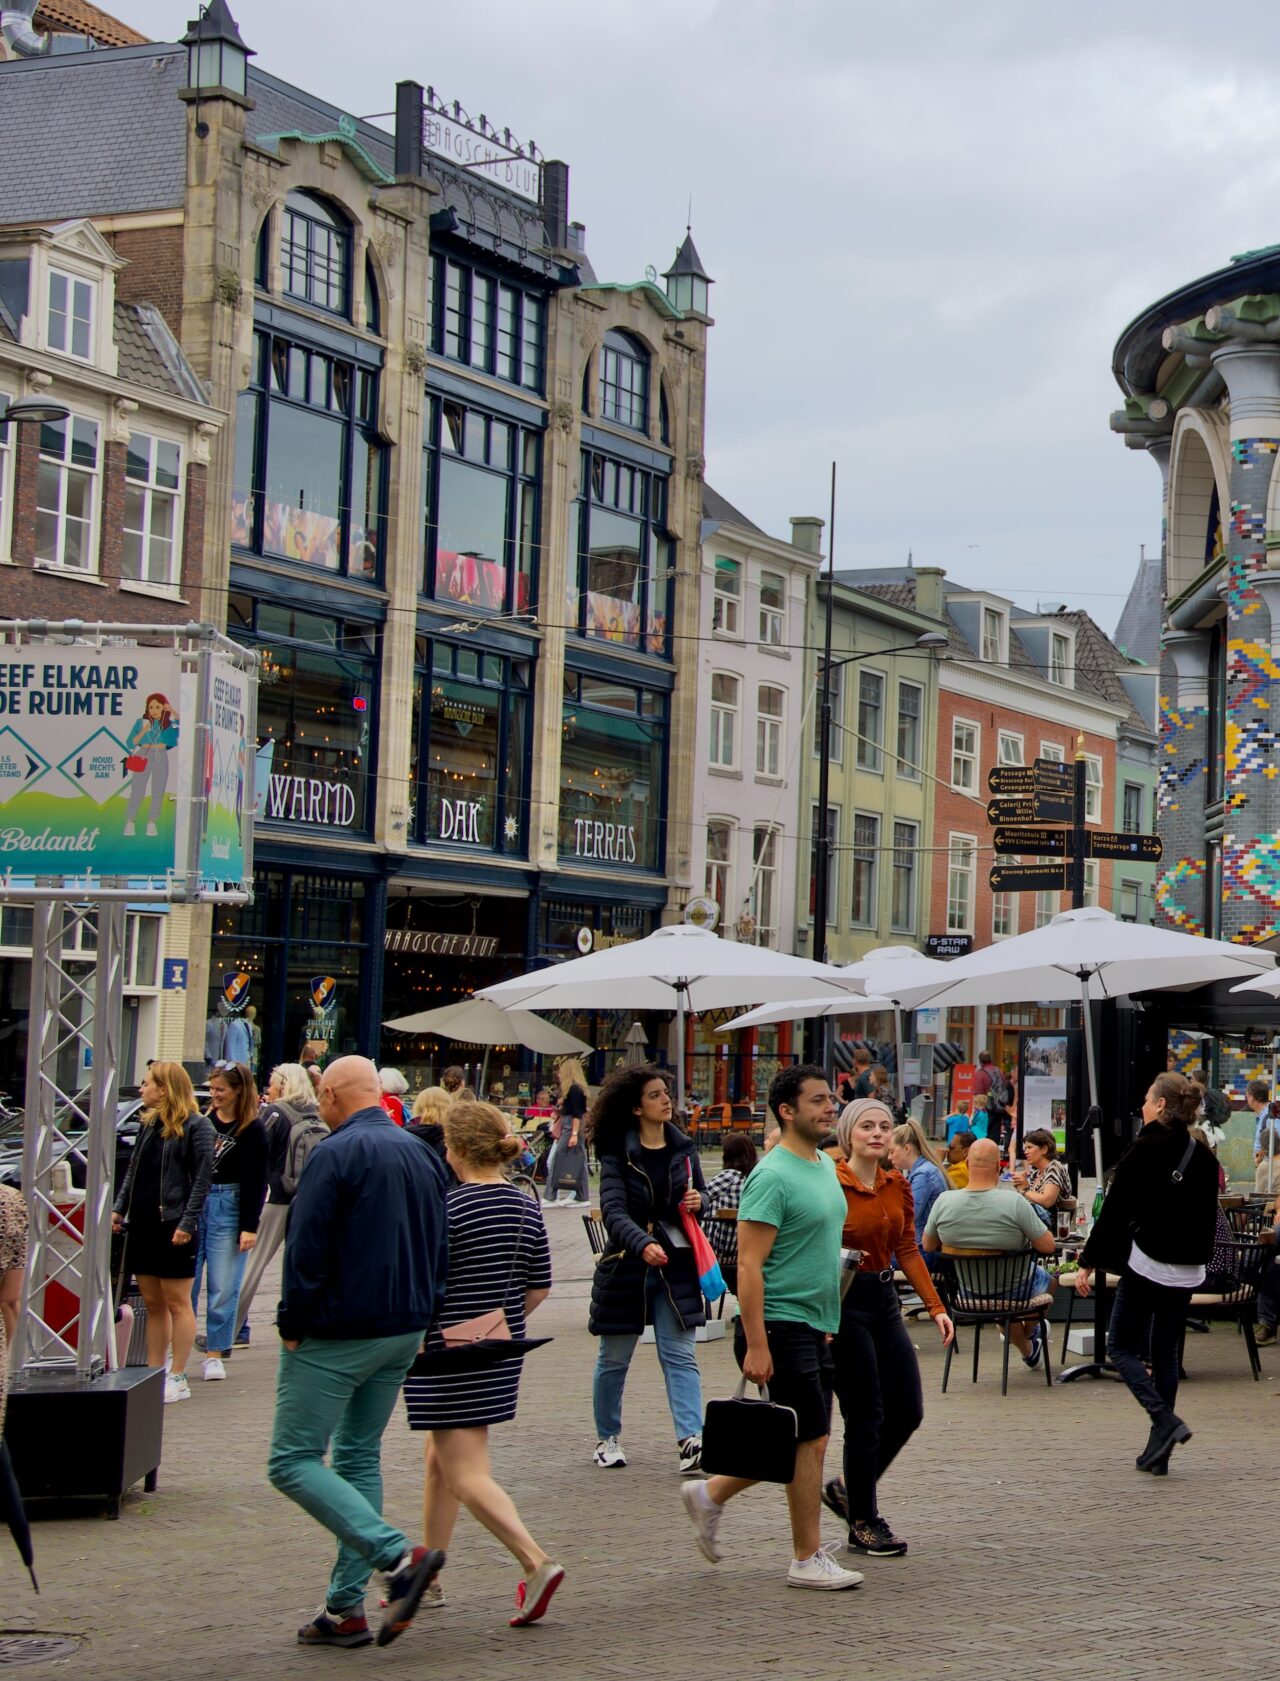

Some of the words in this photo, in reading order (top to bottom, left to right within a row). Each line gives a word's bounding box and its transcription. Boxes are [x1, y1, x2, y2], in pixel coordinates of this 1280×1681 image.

[505, 160, 538, 195] BLUF
[43, 664, 138, 689] ELKAAR
[29, 691, 123, 716] RUIMTE
[92, 756, 113, 764] HOUD
[95, 771, 110, 779] AAN
[1000, 770, 1026, 778] Passage
[440, 799, 480, 843] DAK
[0, 826, 100, 851] Bedankt
[575, 818, 636, 864] TERRAS
[1093, 842, 1129, 851] Torengarage
[384, 931, 458, 954] HAAGSCHE
[461, 937, 497, 957] BLUF
[305, 1029, 335, 1039] SALE
